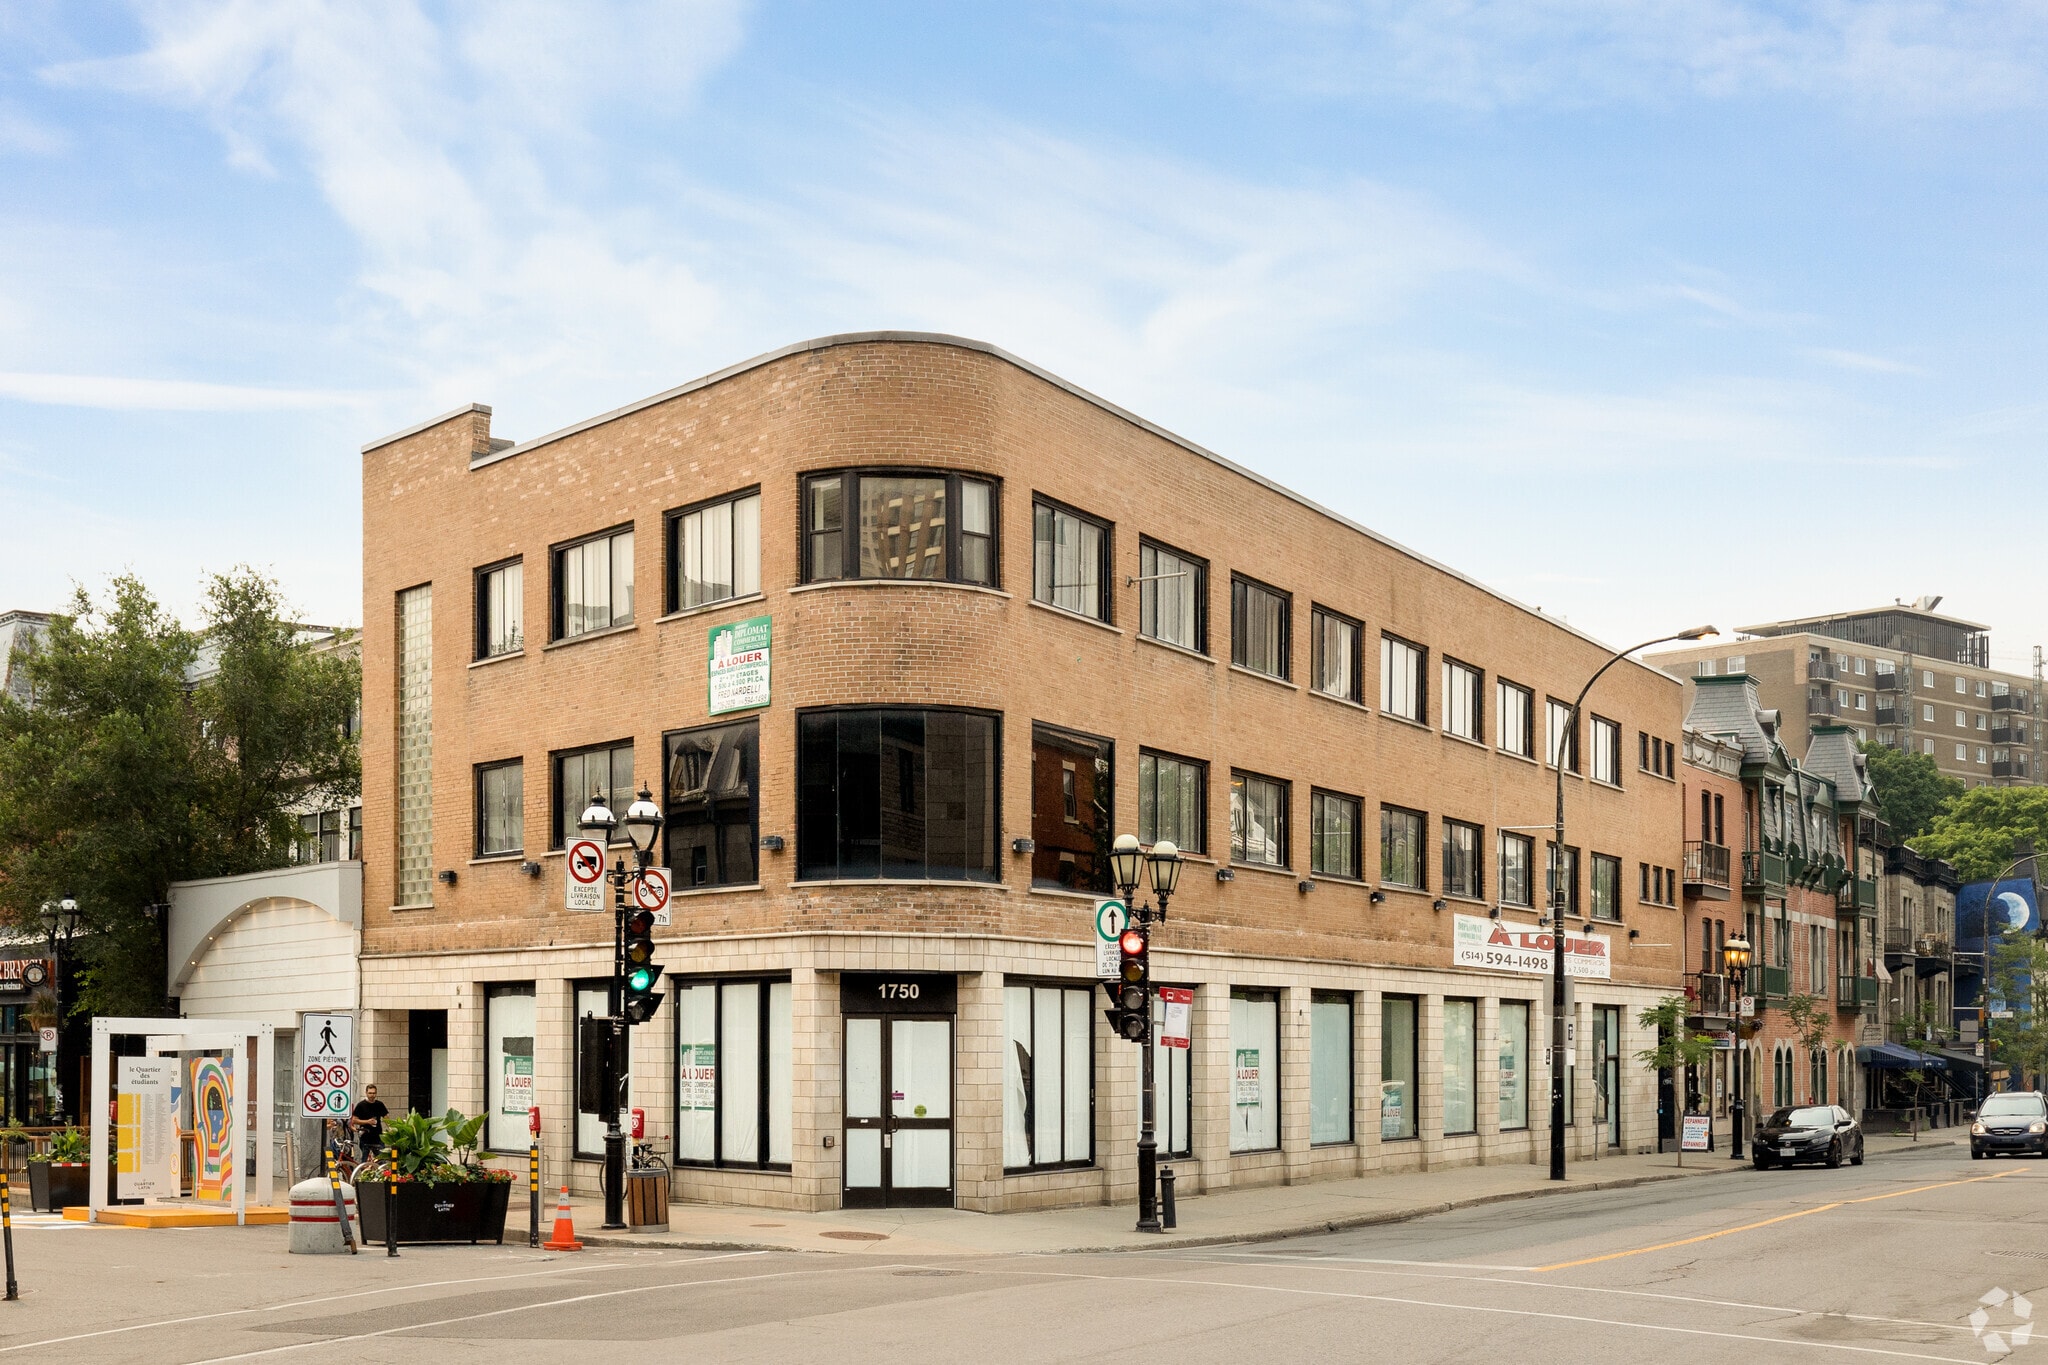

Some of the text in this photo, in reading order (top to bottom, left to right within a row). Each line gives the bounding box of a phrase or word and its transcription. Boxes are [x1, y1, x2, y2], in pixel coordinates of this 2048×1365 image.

[734, 624, 768, 638] DIPLOMAT
[727, 652, 762, 667] LOUER
[658, 914, 667, 922] 7h
[1488, 922, 1606, 957] À LOUER
[1461, 951, 1484, 962] (514)
[1486, 952, 1548, 969] 594-1498
[878, 984, 919, 998] 1750
[322, 1055, 347, 1063] PIÉTONNE
[1242, 1069, 1259, 1079] LOUER
[511, 1077, 532, 1088] LOUER
